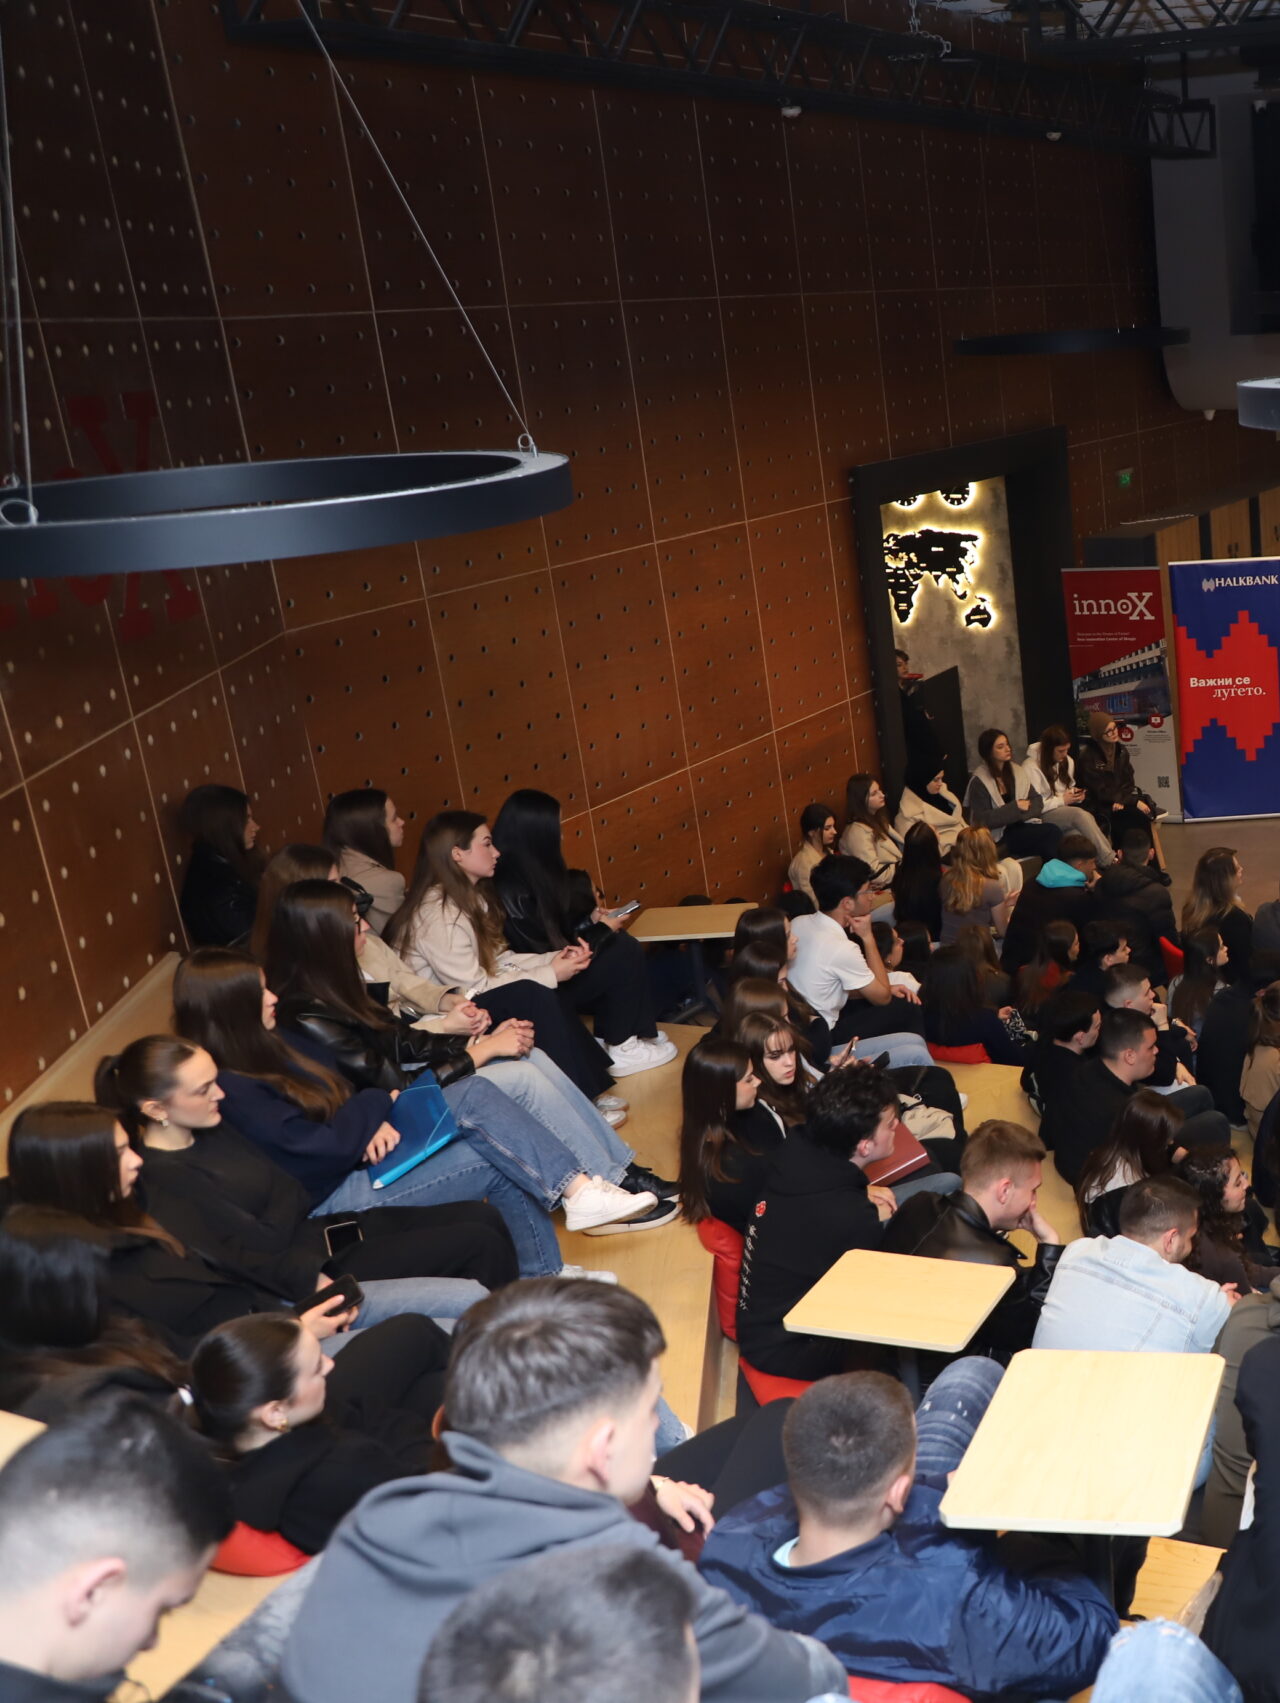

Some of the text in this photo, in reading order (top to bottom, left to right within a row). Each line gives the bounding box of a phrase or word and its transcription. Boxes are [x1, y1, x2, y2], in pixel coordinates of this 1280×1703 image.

[1215, 575, 1279, 587] HALKBANK
[1072, 592, 1156, 621] innoX
[1190, 676, 1251, 688] Важни се
